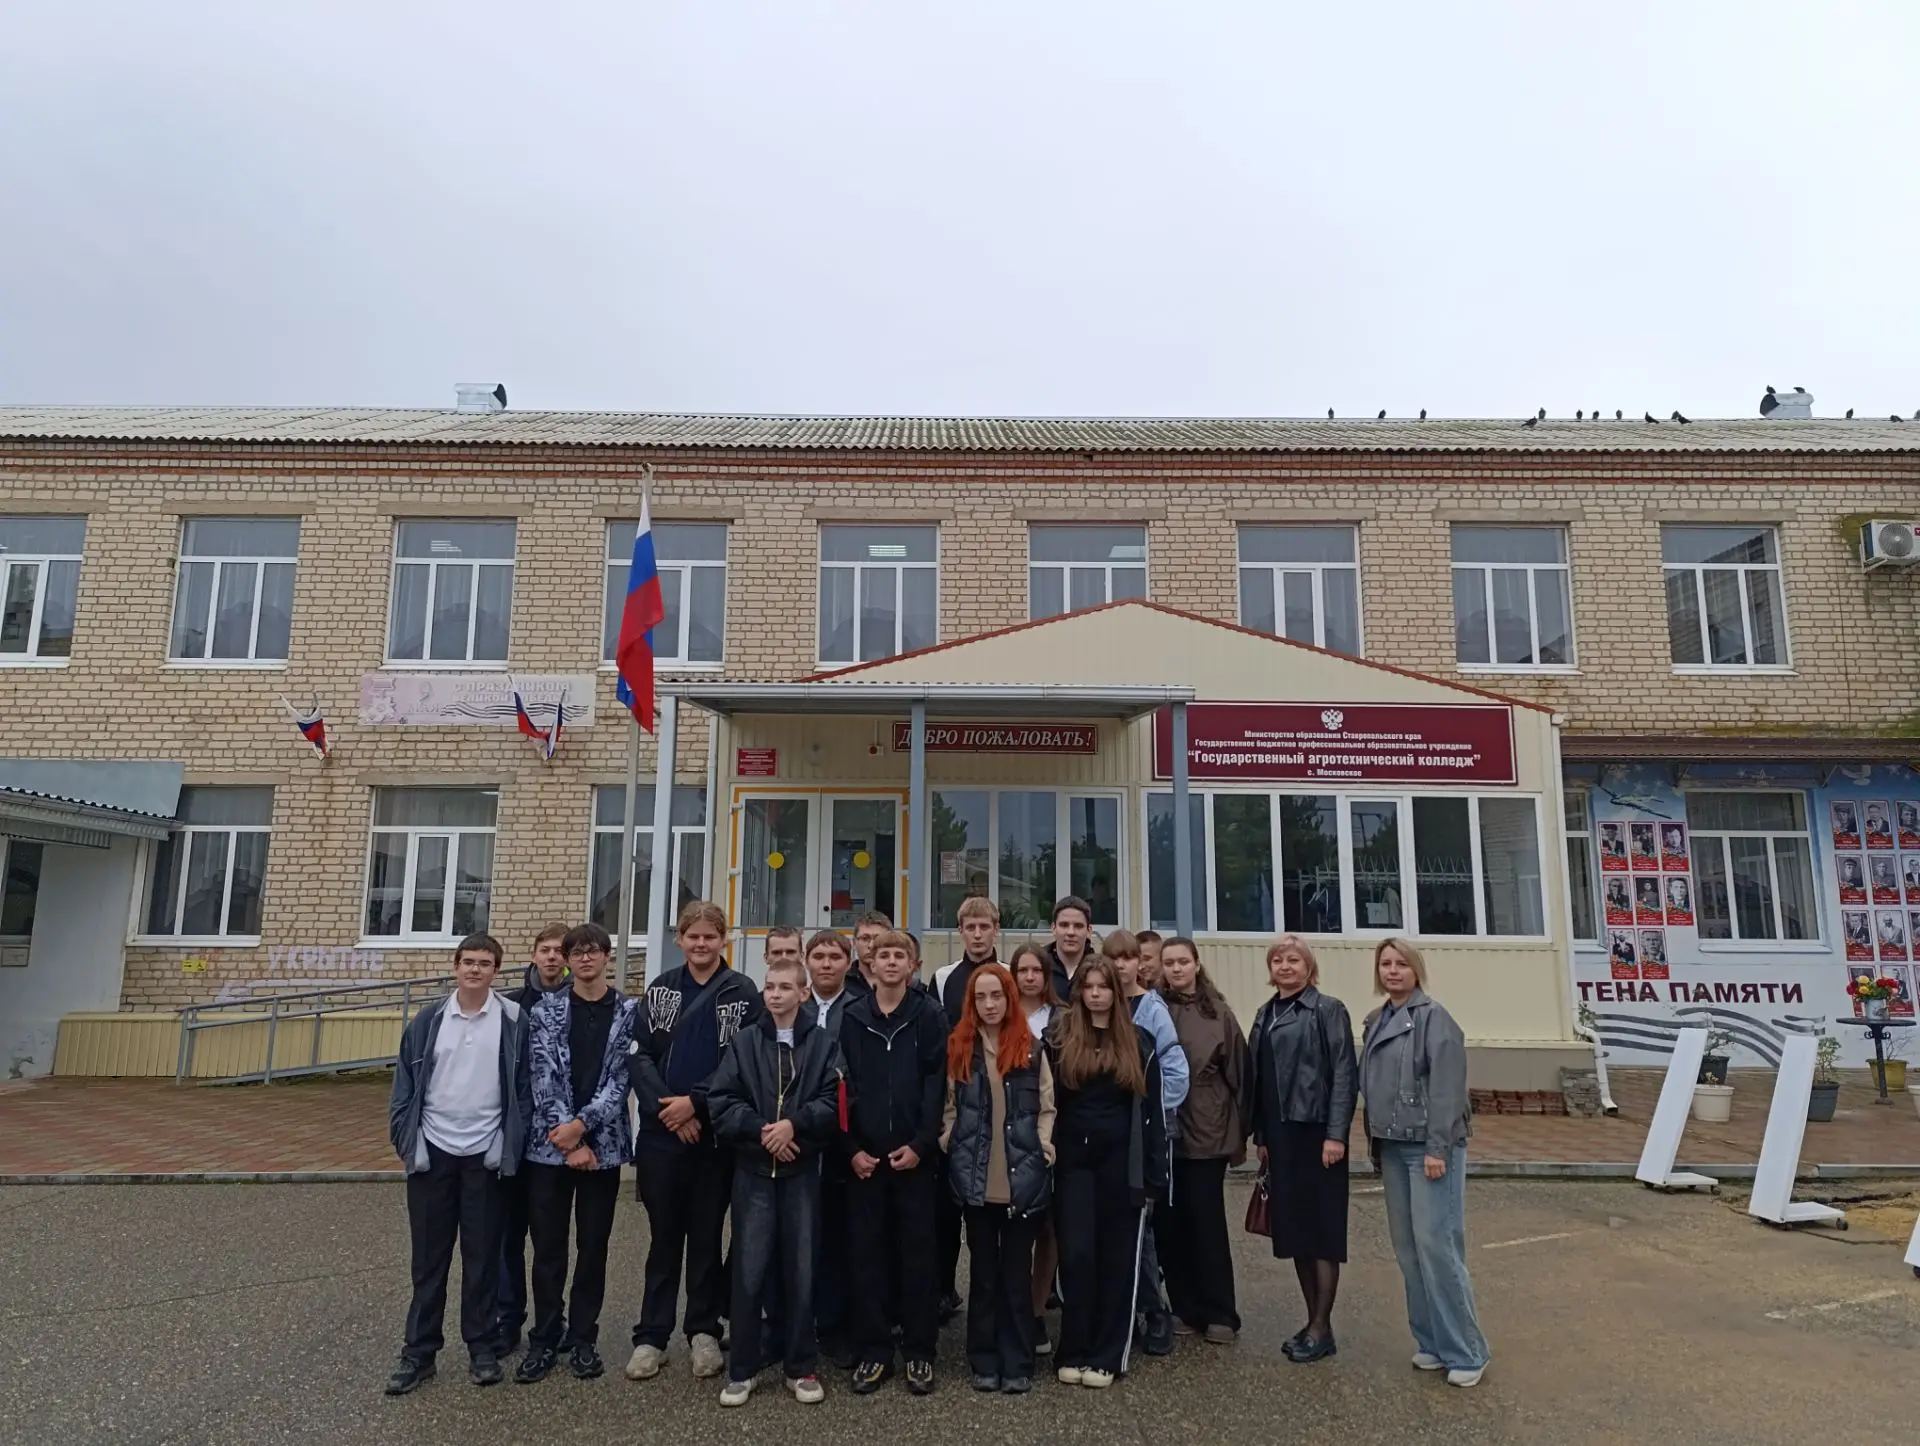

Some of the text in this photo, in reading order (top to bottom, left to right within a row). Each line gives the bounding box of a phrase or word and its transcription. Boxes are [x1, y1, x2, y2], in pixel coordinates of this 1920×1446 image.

[898, 729, 1092, 748] ДБРО ПОЖАЛОВАТЬ!
[1244, 730, 1422, 742] Министерство образования Ставропольского края
[1194, 739, 1472, 752] Государственное бюджетное профессиональное образовательное учреждение
[1308, 753, 1415, 767] агротехнический
[1307, 768, 1362, 777] с. Московское
[267, 945, 385, 972] УКРЫТИЕ
[1669, 982, 1804, 1004] ПАМЯТИ
